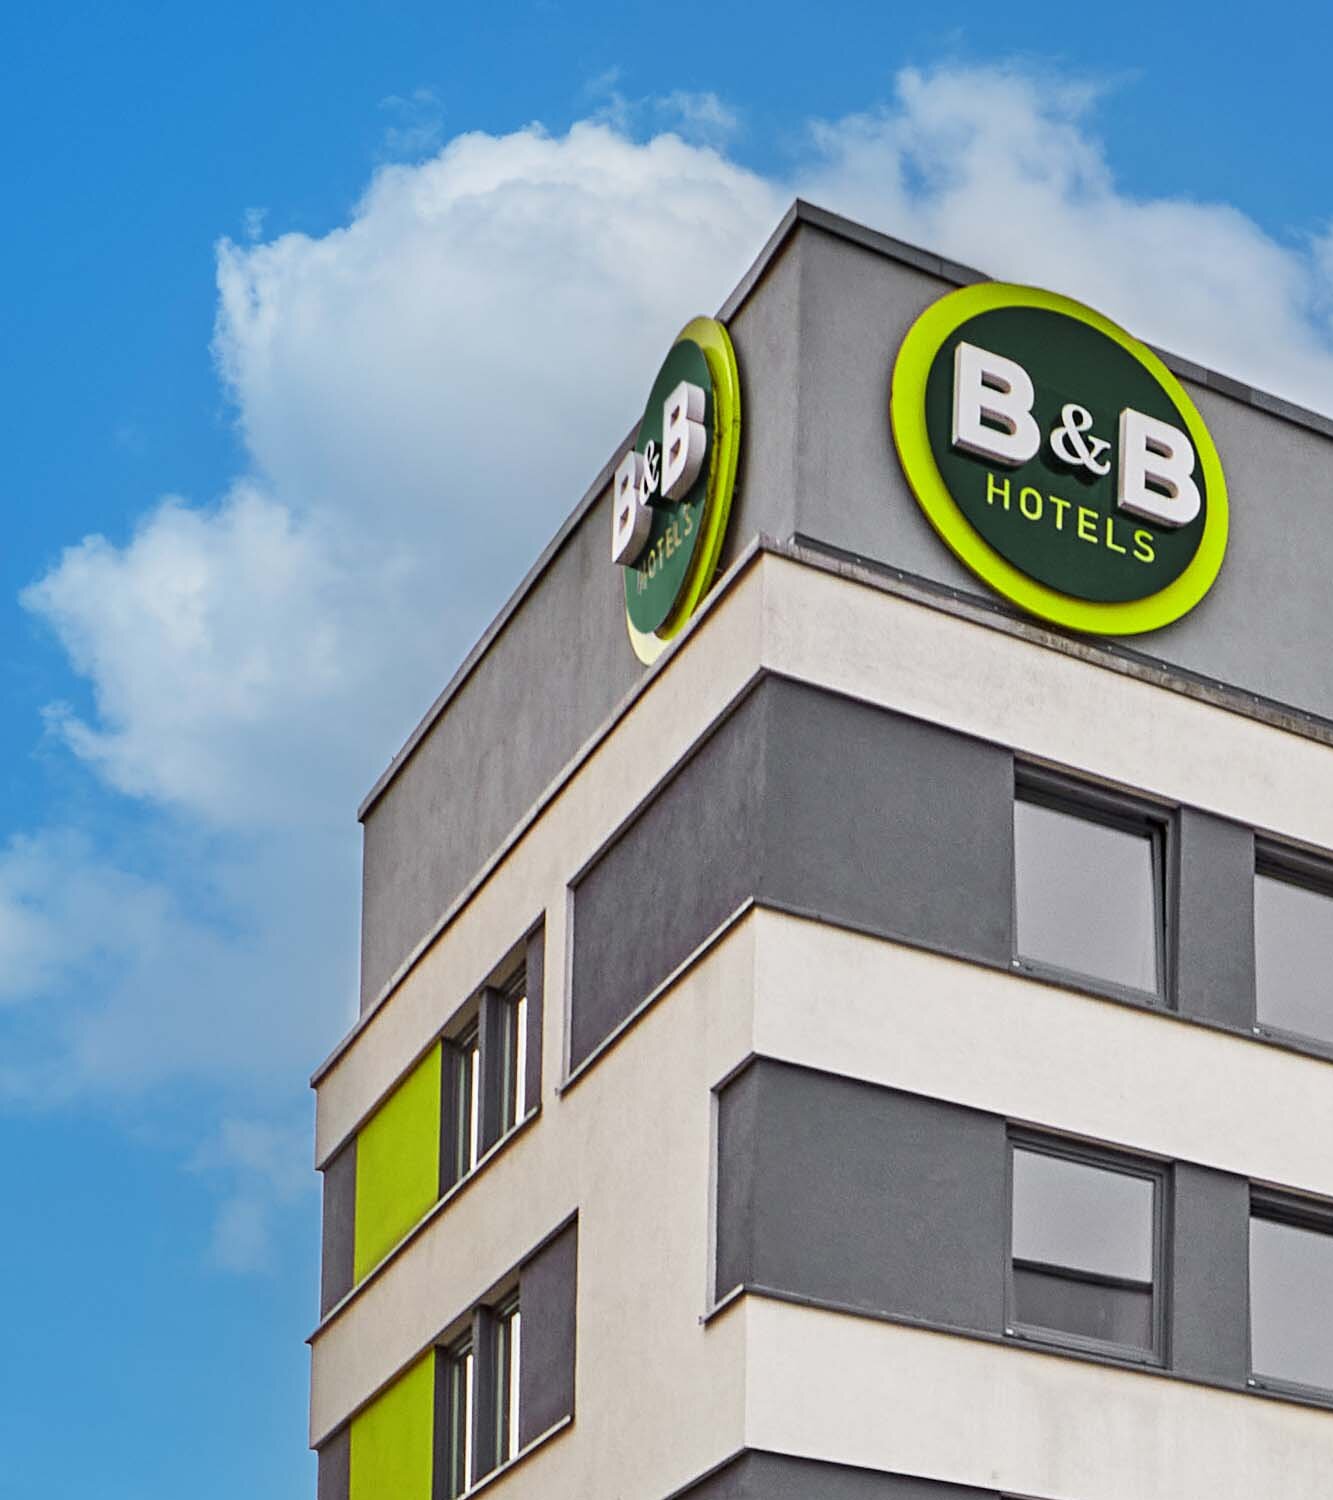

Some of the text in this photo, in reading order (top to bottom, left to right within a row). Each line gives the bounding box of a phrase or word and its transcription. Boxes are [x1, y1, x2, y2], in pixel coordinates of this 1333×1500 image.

[611, 381, 706, 565] B&B
[952, 341, 1201, 528] B&B
[637, 503, 693, 594] HOTELS
[986, 472, 1155, 564] HOTELS
